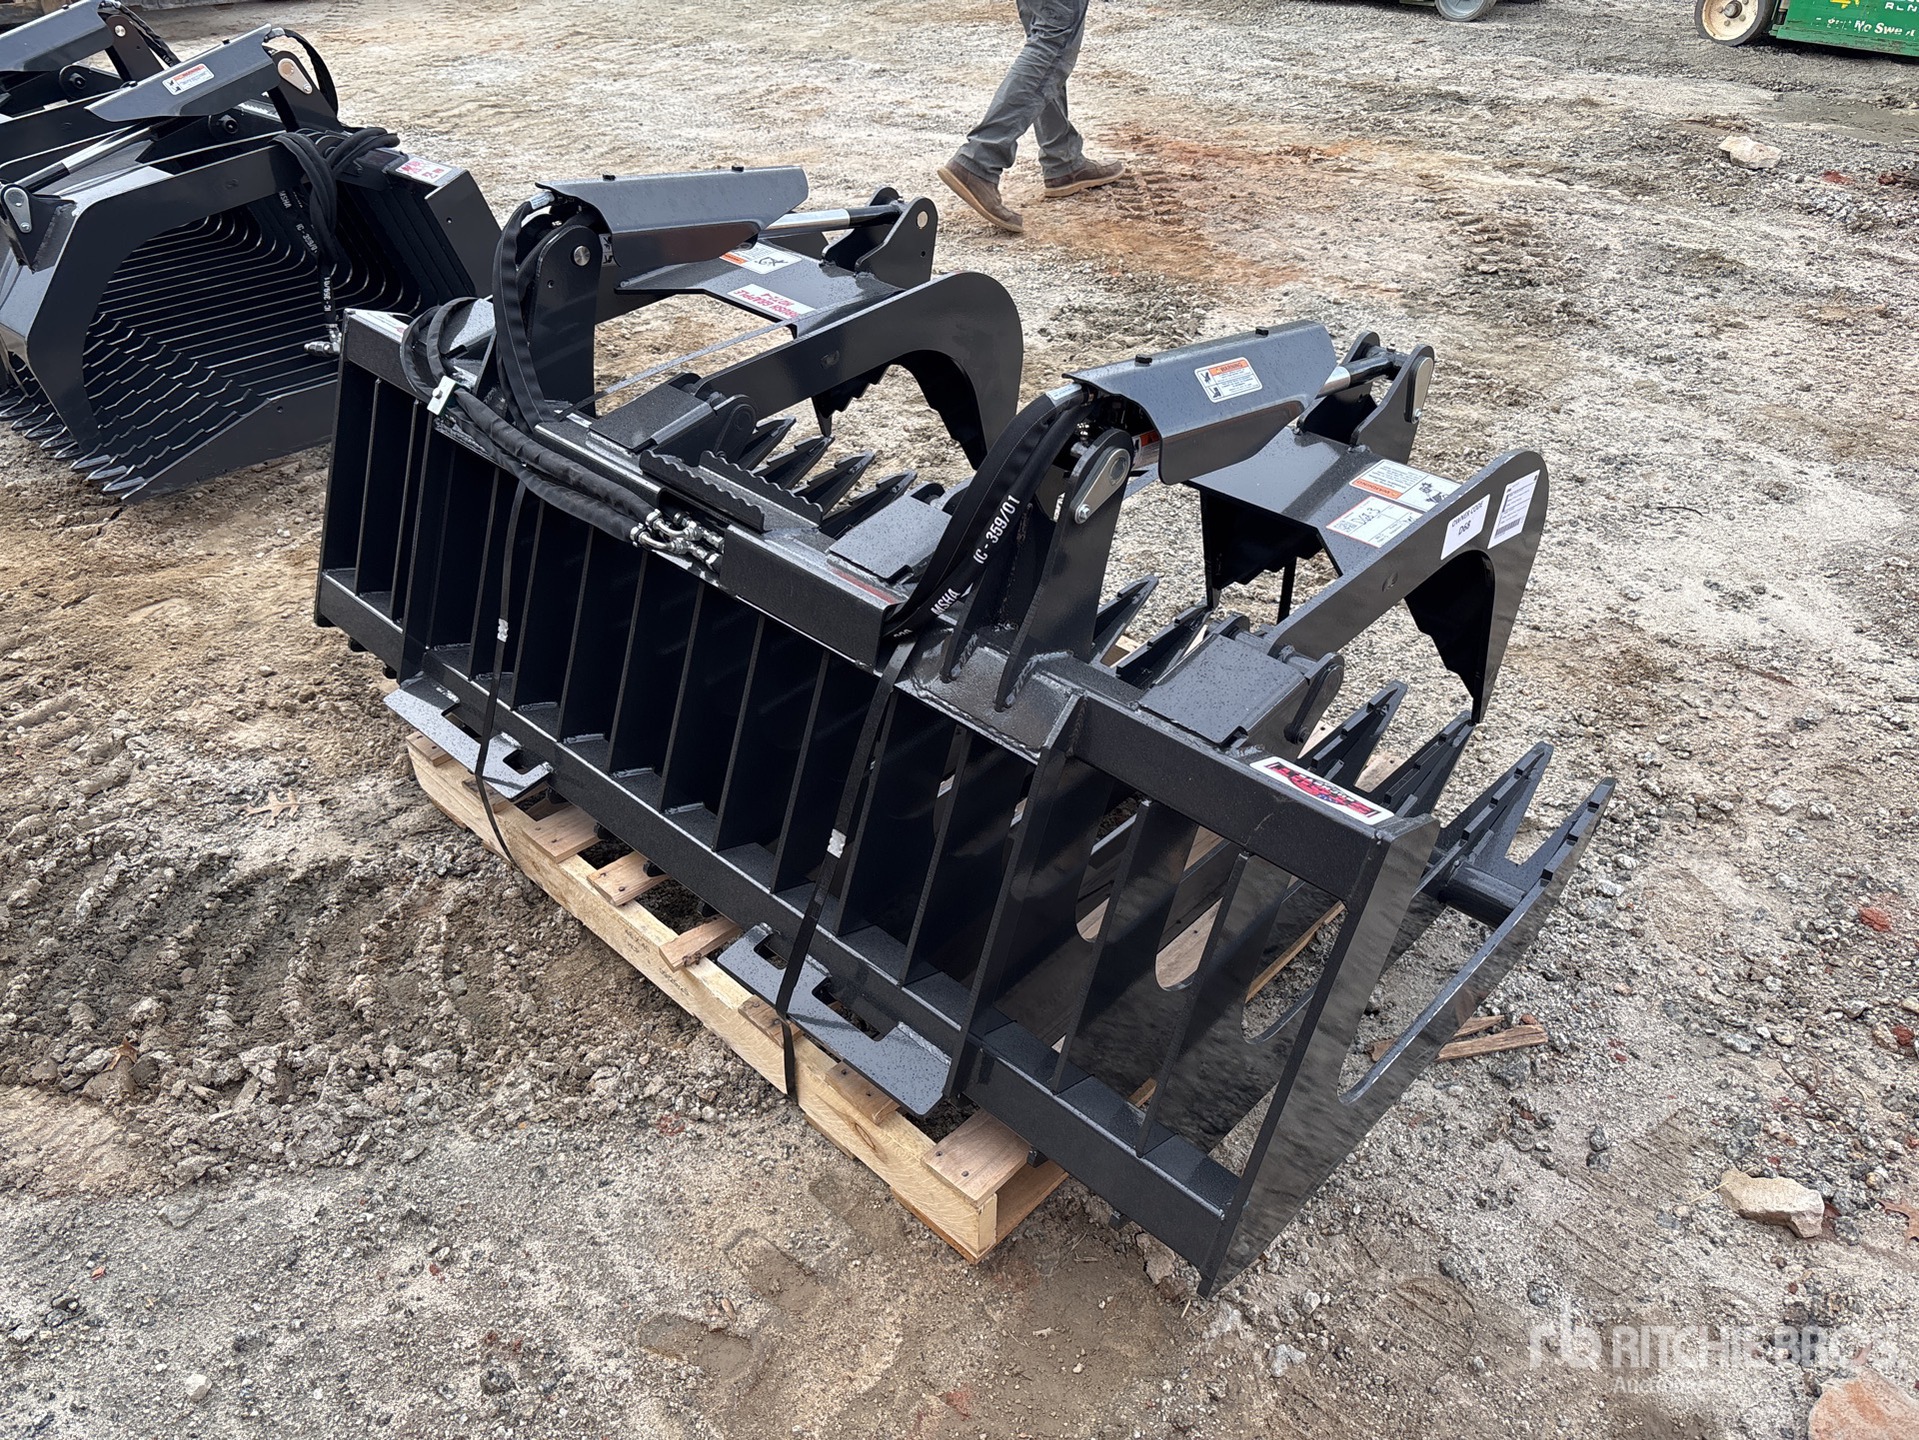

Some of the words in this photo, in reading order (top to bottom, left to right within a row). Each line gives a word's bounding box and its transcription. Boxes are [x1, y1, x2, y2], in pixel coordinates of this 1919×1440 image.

[973, 548, 989, 565] IC
[985, 494, 1020, 544] 359/01
[930, 588, 961, 616] MSHA
